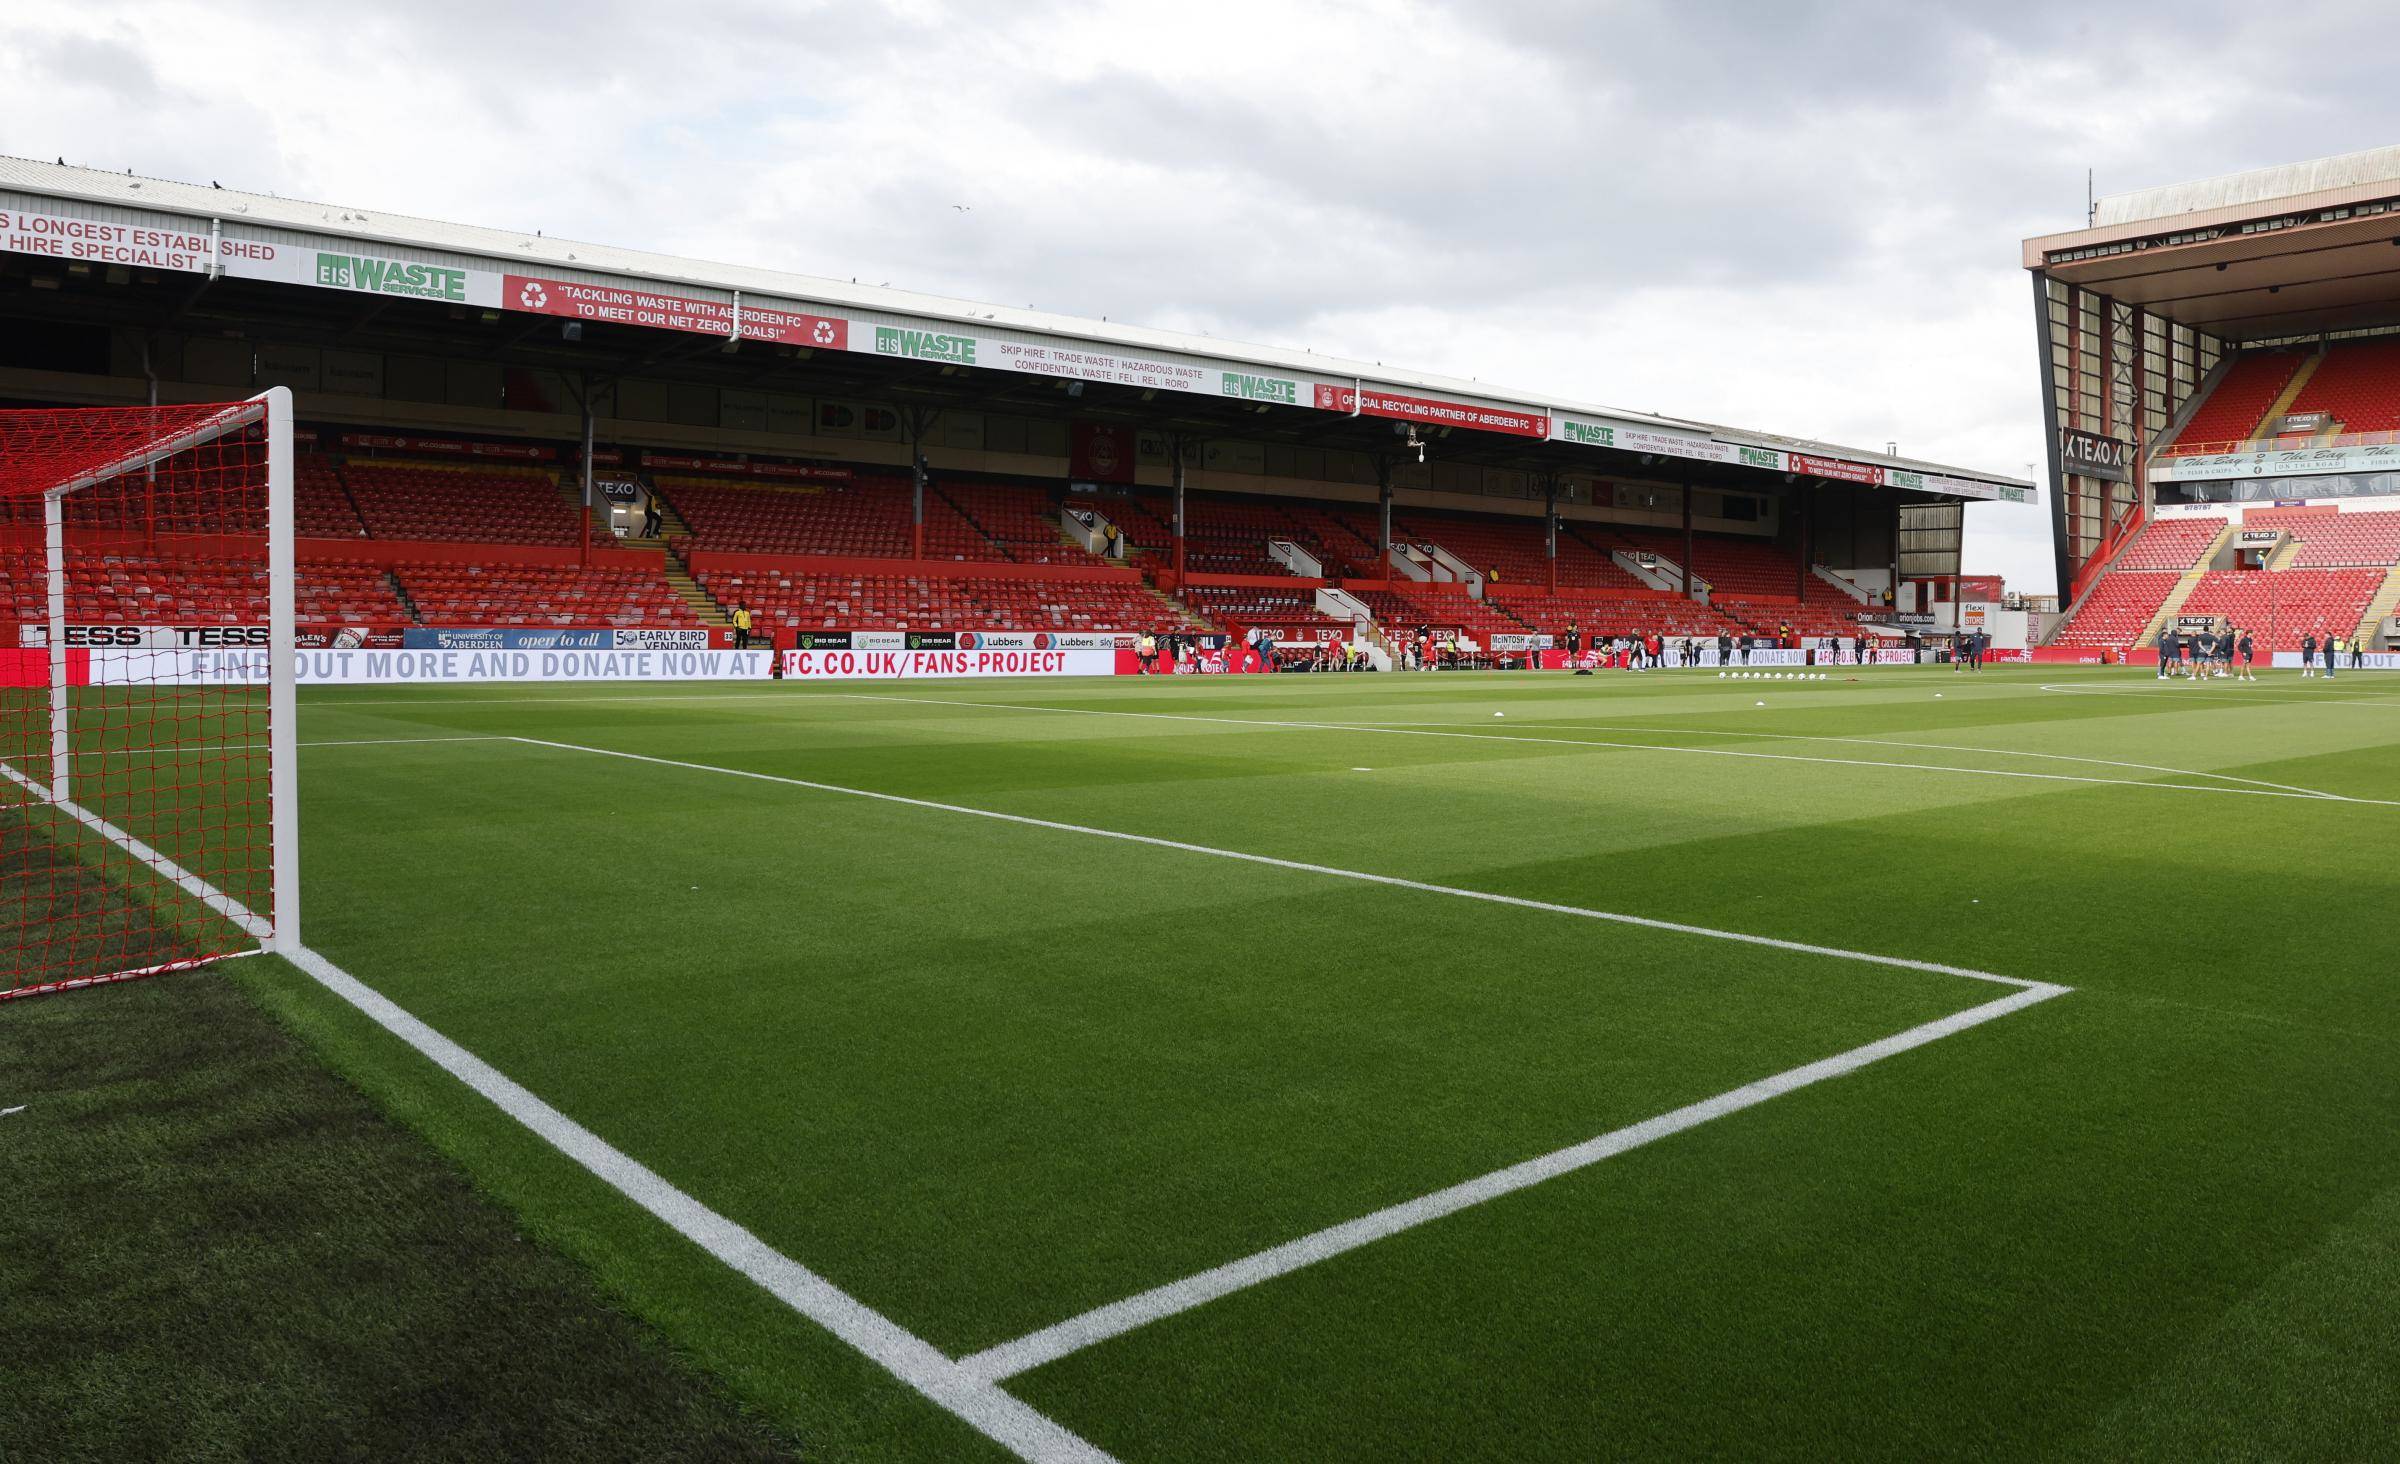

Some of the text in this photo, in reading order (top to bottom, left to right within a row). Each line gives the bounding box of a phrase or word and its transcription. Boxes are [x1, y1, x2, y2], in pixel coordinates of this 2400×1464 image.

[19, 216, 126, 243] LONGEST
[133, 230, 275, 261] ESTABLSHED
[10, 235, 63, 254] HIRE
[71, 242, 197, 270] SPECIALIST
[320, 257, 466, 301] EIS WASTE
[383, 282, 444, 299] SERVICES
[577, 303, 731, 334] TO MEET OUR NET ZERO
[637, 296, 682, 312] WASTE
[685, 302, 715, 317] WITH
[786, 317, 801, 328] FC
[878, 330, 976, 364] EIS WASTE
[920, 350, 961, 362] SERVICES
[1001, 345, 1203, 379] SKIP HIRE TRADE WASTE HAZARDOUS WASTE
[1015, 360, 1189, 389] CONFIDENTIAL WASTE FEL REL RORO
[1224, 375, 1296, 403] EIS WASTE
[1343, 395, 1530, 430] OFCIAL RECYCLING PARTNER OF ABERDEEN FC
[1576, 423, 1613, 446] WASTE
[1625, 432, 1729, 453] SKIP HIRE TRADE WASTE HAZARDOUS WASTE
[1633, 442, 1666, 453] CONFIDENTIAL
[1667, 447, 1683, 455] WASTE
[2077, 437, 2110, 464] TEXO
[1748, 448, 1778, 468] WASTE
[598, 482, 634, 494] TEXO
[1965, 604, 1984, 612] flexi
[1899, 613, 1935, 624] orionjobs.com
[1965, 616, 1984, 624] STORE
[175, 627, 269, 646] TESS
[451, 641, 503, 649] ABERDEEN
[519, 632, 600, 649] open to all
[639, 631, 706, 641] EARLY BIRD
[988, 637, 1023, 647] Lubbers
[1061, 637, 1094, 647] Lubbers
[1100, 638, 1113, 648] sky
[1881, 639, 1898, 648] GROUP
[644, 642, 701, 650] VENDING
[192, 652, 759, 679] FIND OUT MORE AND DONATE NOW AT
[1753, 651, 1784, 664] DONATE
[1787, 651, 1805, 663] NOW
